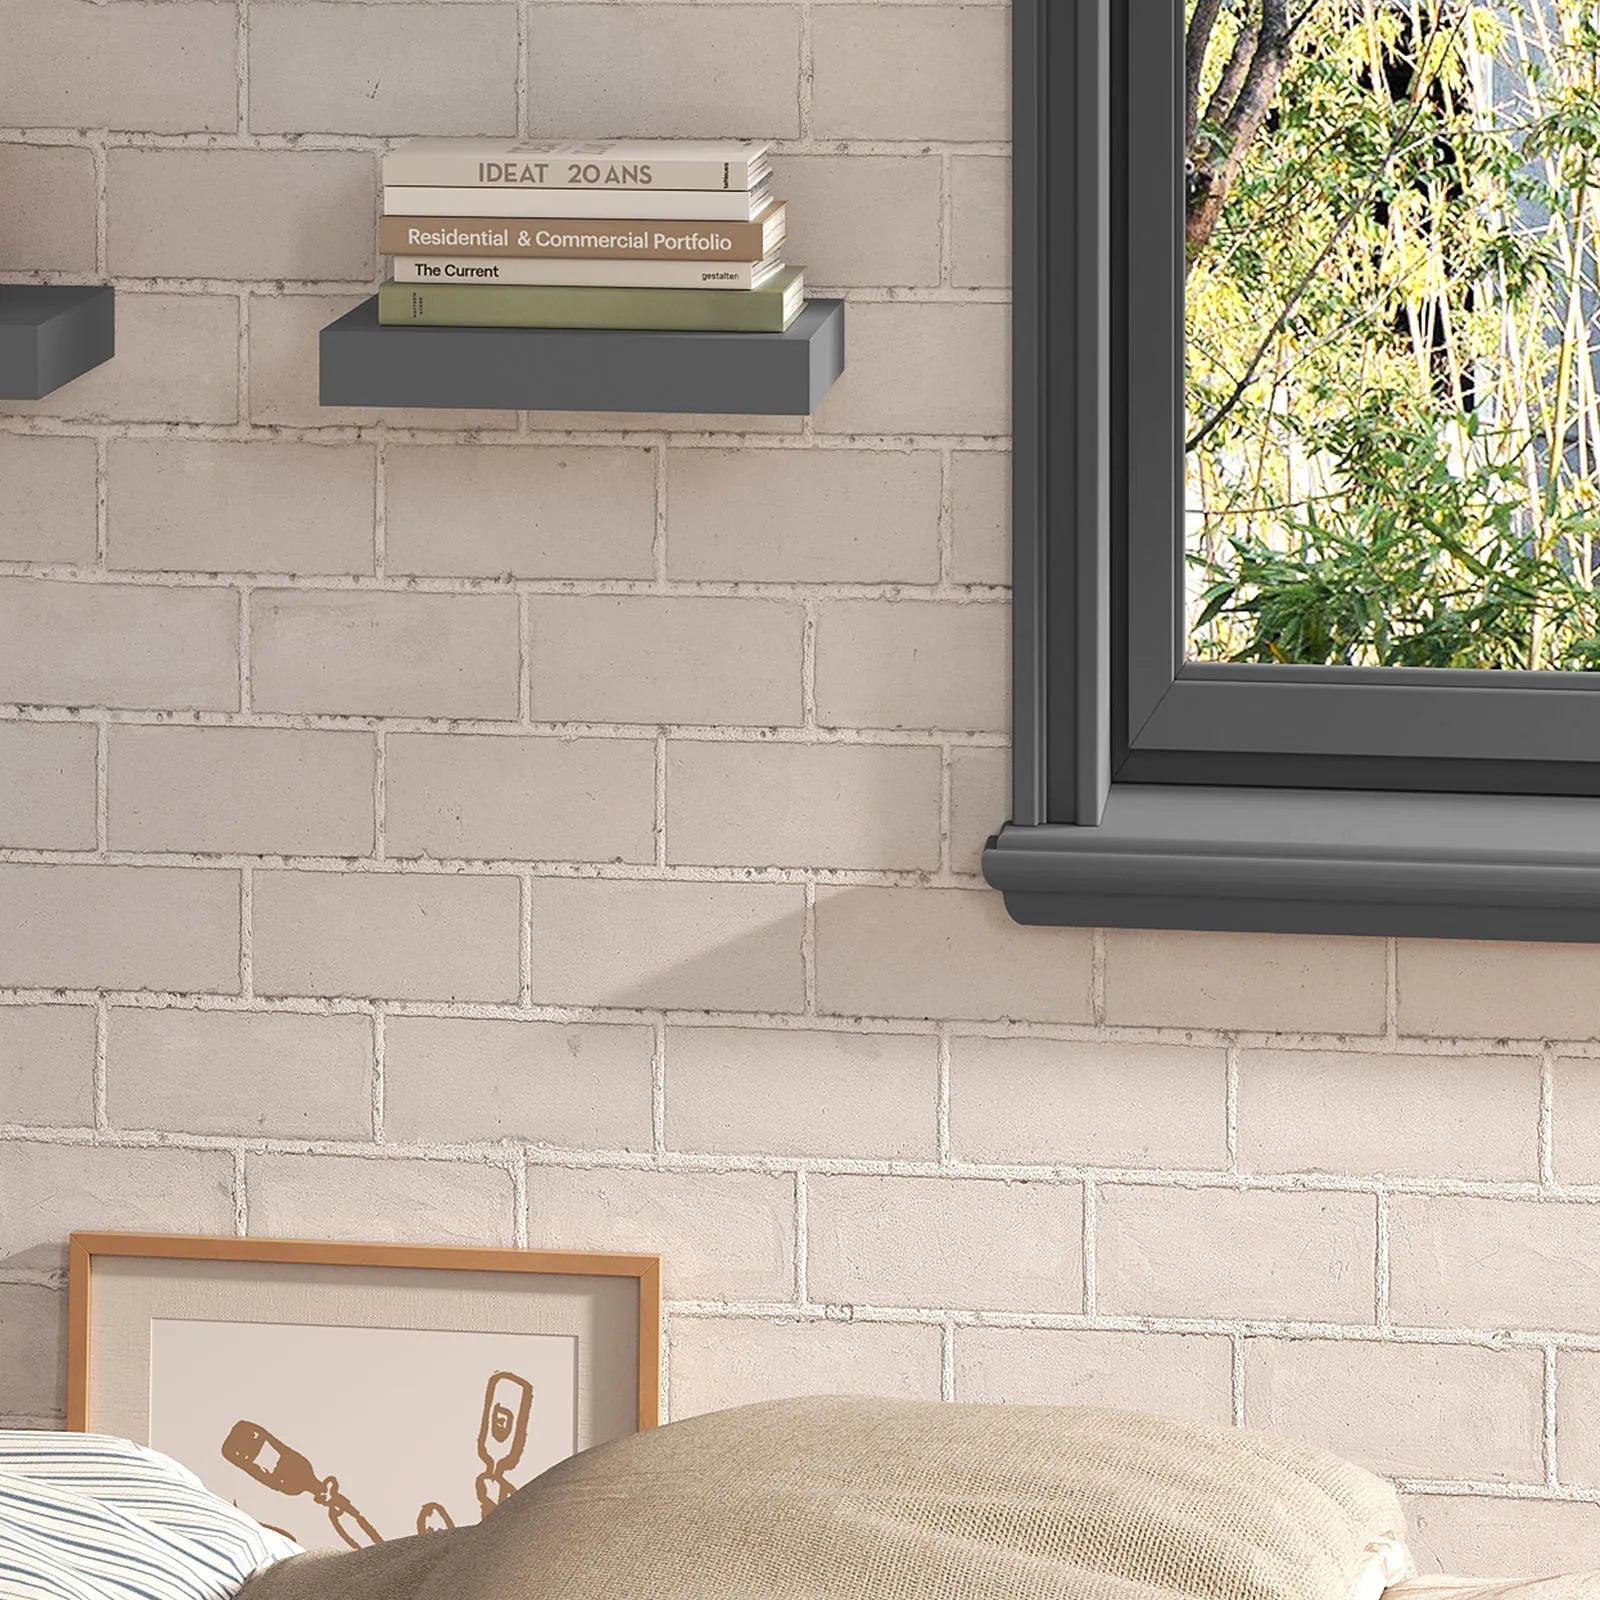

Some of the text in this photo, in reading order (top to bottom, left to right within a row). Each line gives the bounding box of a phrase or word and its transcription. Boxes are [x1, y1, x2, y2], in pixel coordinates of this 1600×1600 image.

[479, 162, 652, 185] IDEAT 20 ANS
[408, 228, 732, 251] Residential & Commercial Portfolio
[415, 263, 499, 278] The Current
[701, 271, 739, 281] gestalten
